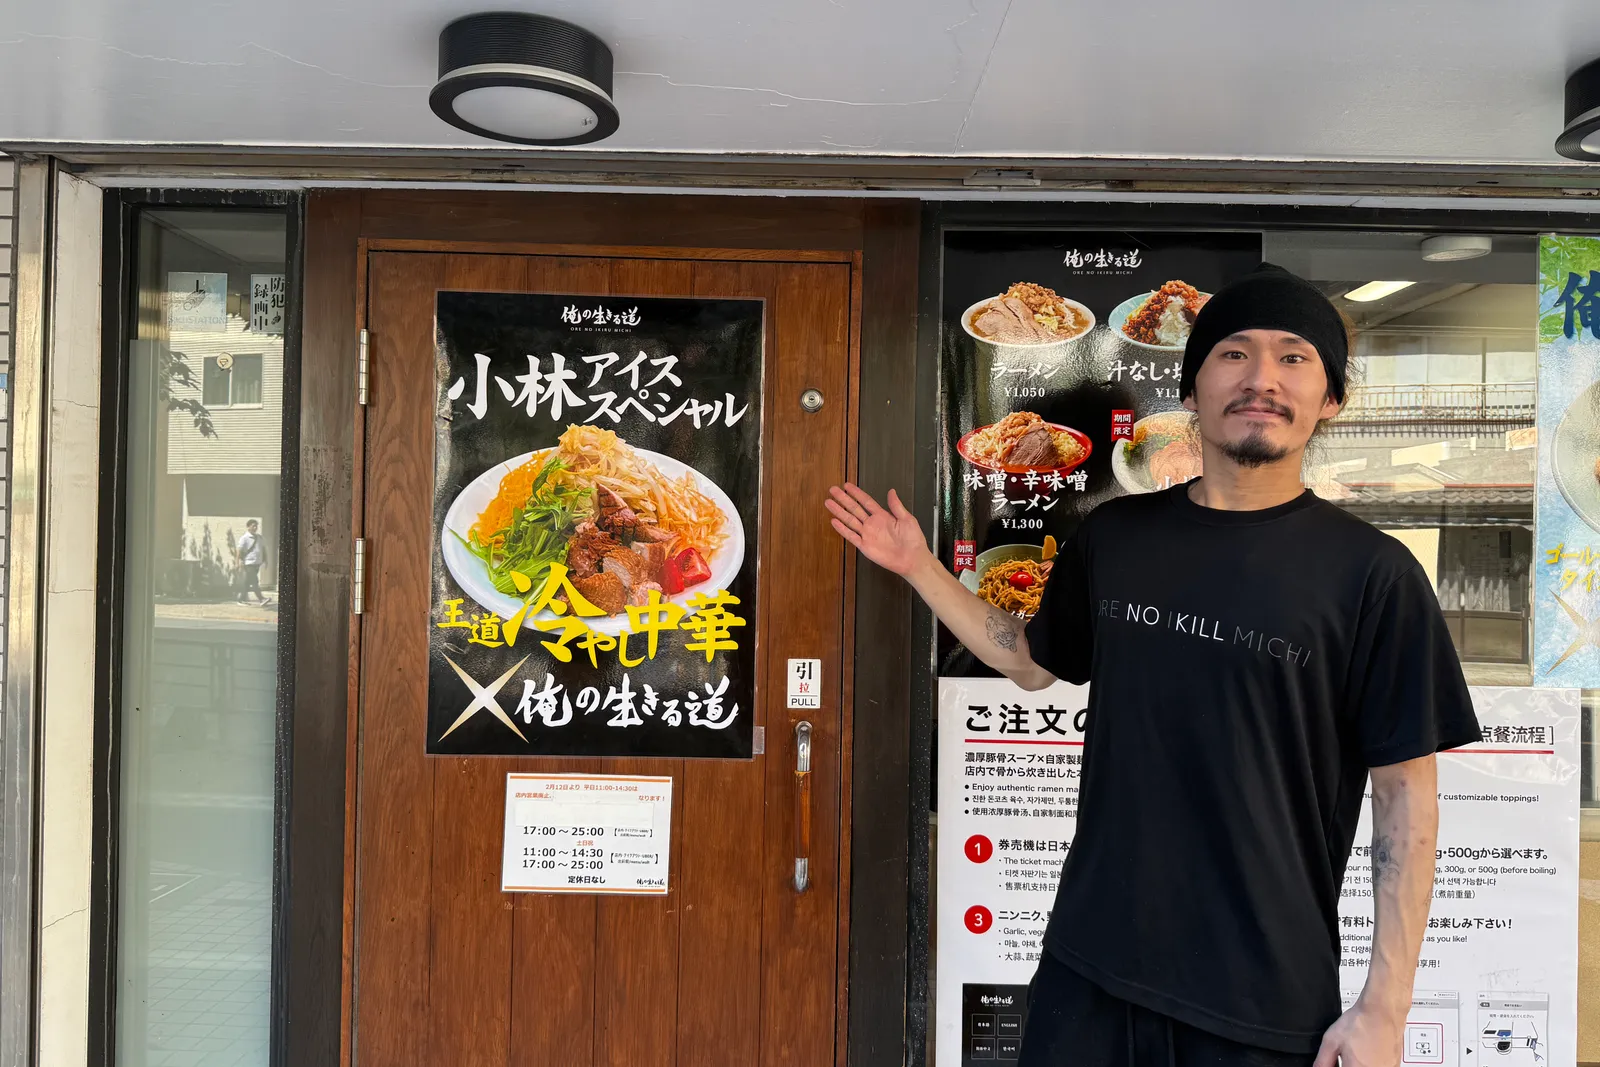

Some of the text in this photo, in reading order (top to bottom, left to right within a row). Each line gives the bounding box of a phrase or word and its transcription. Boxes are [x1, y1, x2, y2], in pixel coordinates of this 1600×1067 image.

[581, 350, 683, 392] アイス
[990, 361, 1061, 381] ラーメン
[448, 353, 587, 421] 小林
[1003, 387, 1046, 398] ¥1,050
[583, 388, 749, 429] スペシャル
[991, 493, 1060, 512] ラーメン
[1001, 518, 1044, 530] ¥1,300
[1098, 599, 1120, 618] RE
[1126, 603, 1160, 625] NO
[1233, 625, 1312, 668] MICHI
[796, 661, 813, 681] 引
[799, 682, 811, 694] 拉
[514, 672, 740, 730] 俺の生きる道
[790, 697, 817, 707] PULL
[972, 783, 995, 791] Enjoy
[1444, 793, 1498, 802] customizable
[1500, 794, 1540, 803] toppings!
[1020, 857, 1042, 865] ticket
[1478, 866, 1498, 874] 500g
[1500, 867, 1528, 875] (before
[1530, 867, 1557, 875] boiling)
[568, 875, 606, 884] 定休日なし
[1447, 878, 1461, 886] 선택
[1003, 928, 1027, 936] Garlic,
[1417, 959, 1440, 968] 享用!
